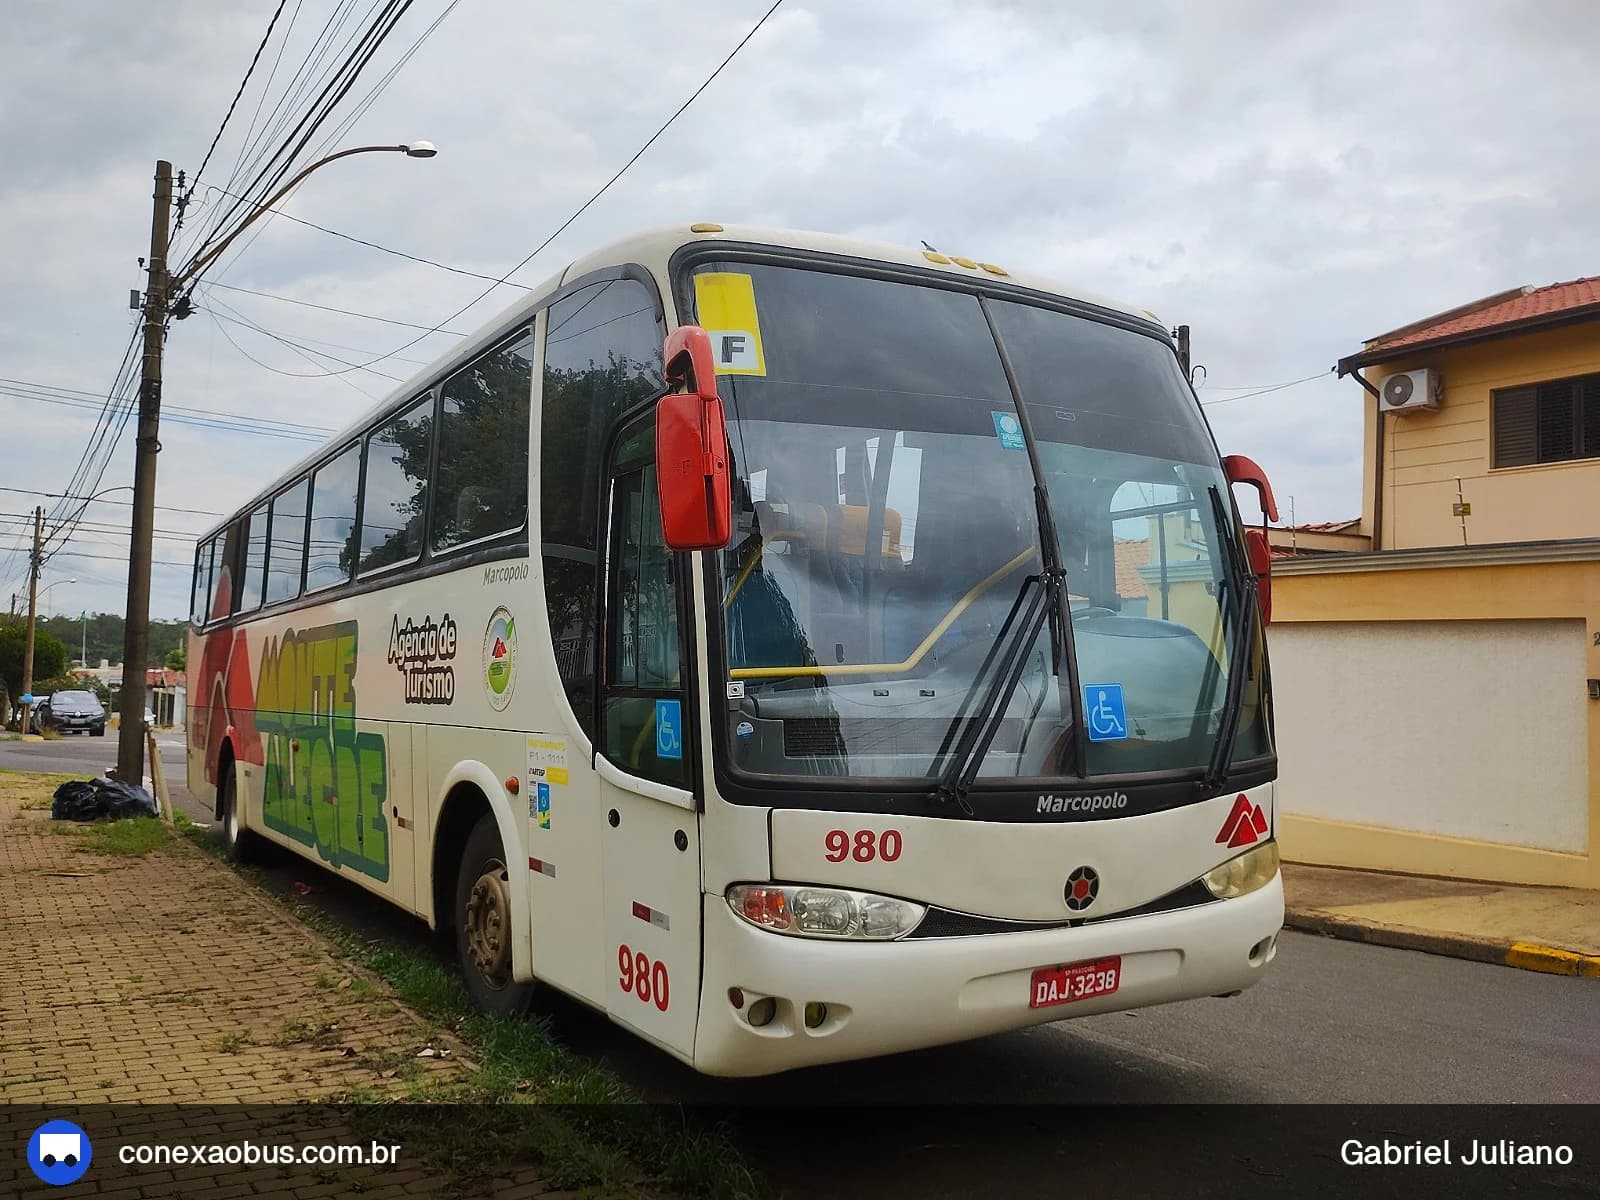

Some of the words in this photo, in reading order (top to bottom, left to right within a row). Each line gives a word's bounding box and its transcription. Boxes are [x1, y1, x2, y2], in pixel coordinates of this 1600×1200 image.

[721, 335, 746, 363] F
[483, 562, 529, 586] Marcopolo
[387, 613, 438, 671] Agência
[438, 612, 457, 660] de
[255, 620, 358, 742] MONTE
[403, 659, 455, 705] Turismo
[1036, 791, 1128, 813] Marcopolo
[824, 828, 904, 864] 980
[617, 943, 670, 1013] 980
